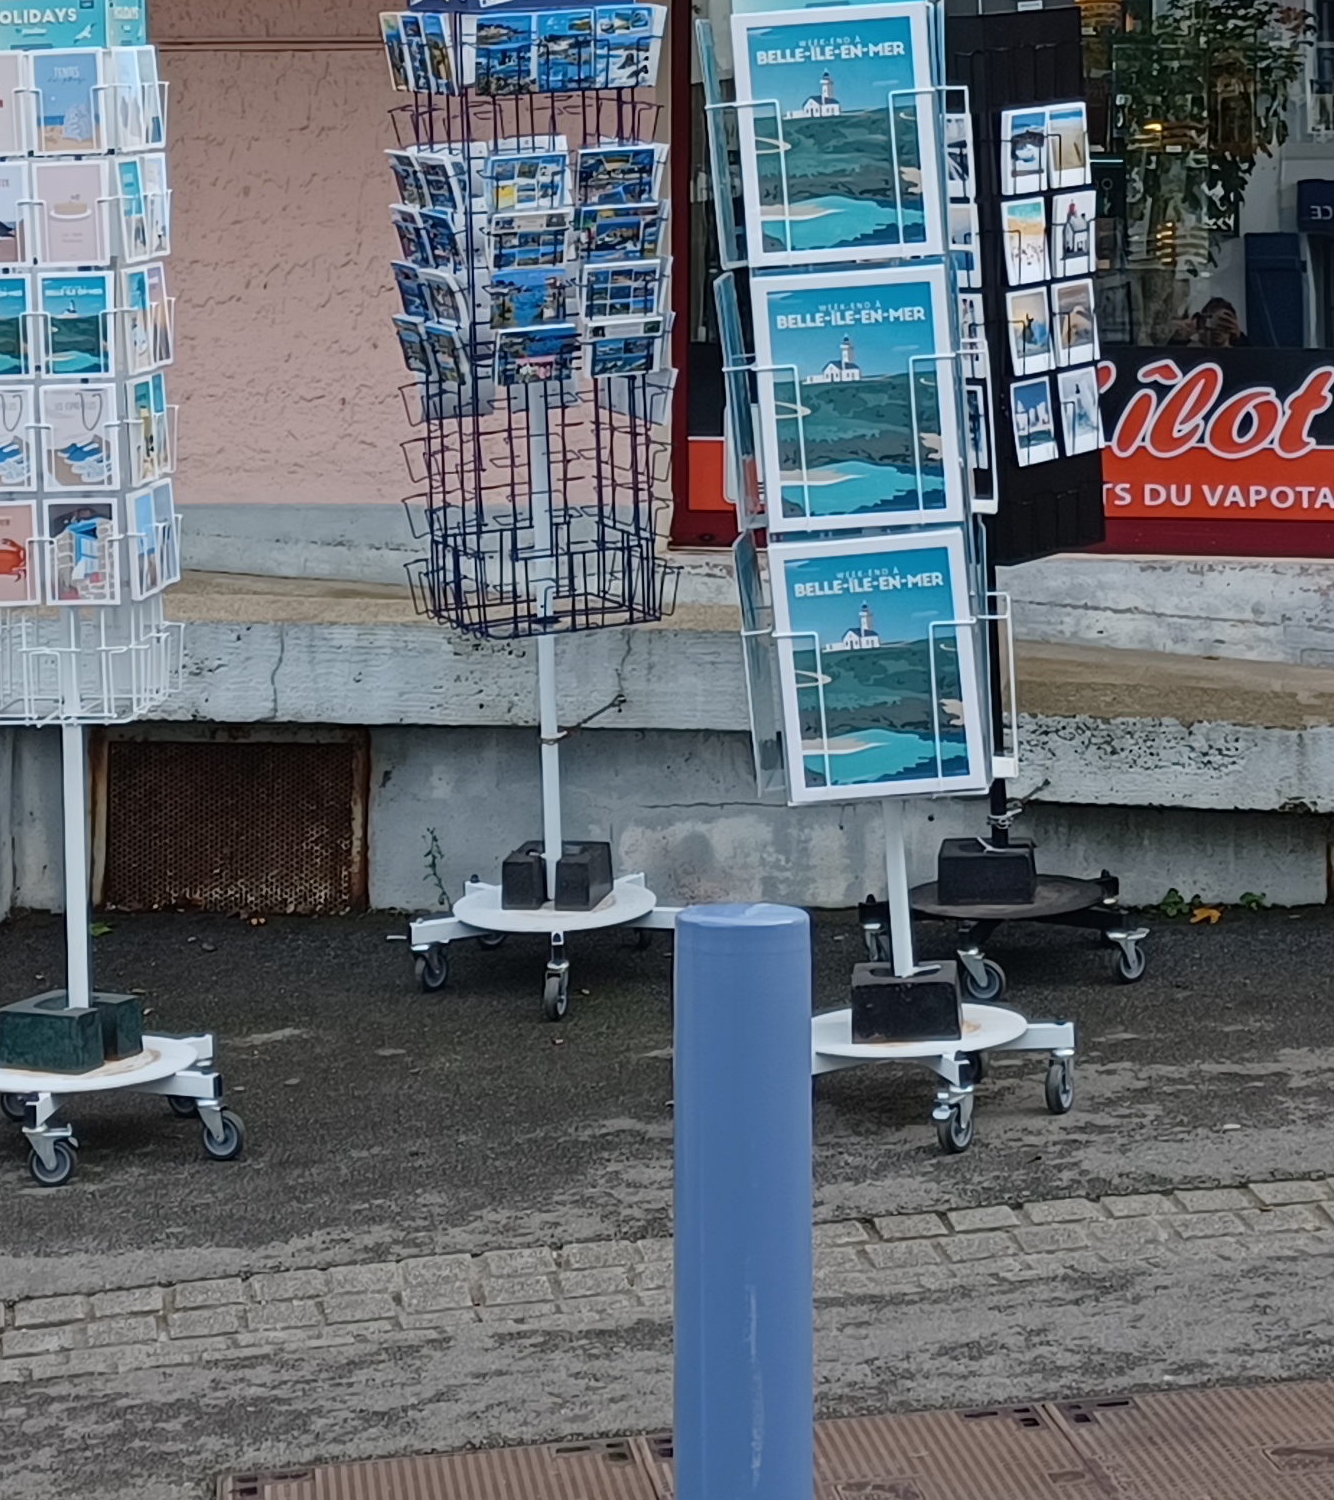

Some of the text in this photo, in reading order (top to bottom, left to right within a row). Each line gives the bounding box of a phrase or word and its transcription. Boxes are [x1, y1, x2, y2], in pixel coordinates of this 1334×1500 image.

[798, 37, 850, 47] WEEK-END
[819, 302, 871, 311] WEEK-END
[1143, 483, 1192, 507] DU
[836, 568, 888, 579] WEEK-END
